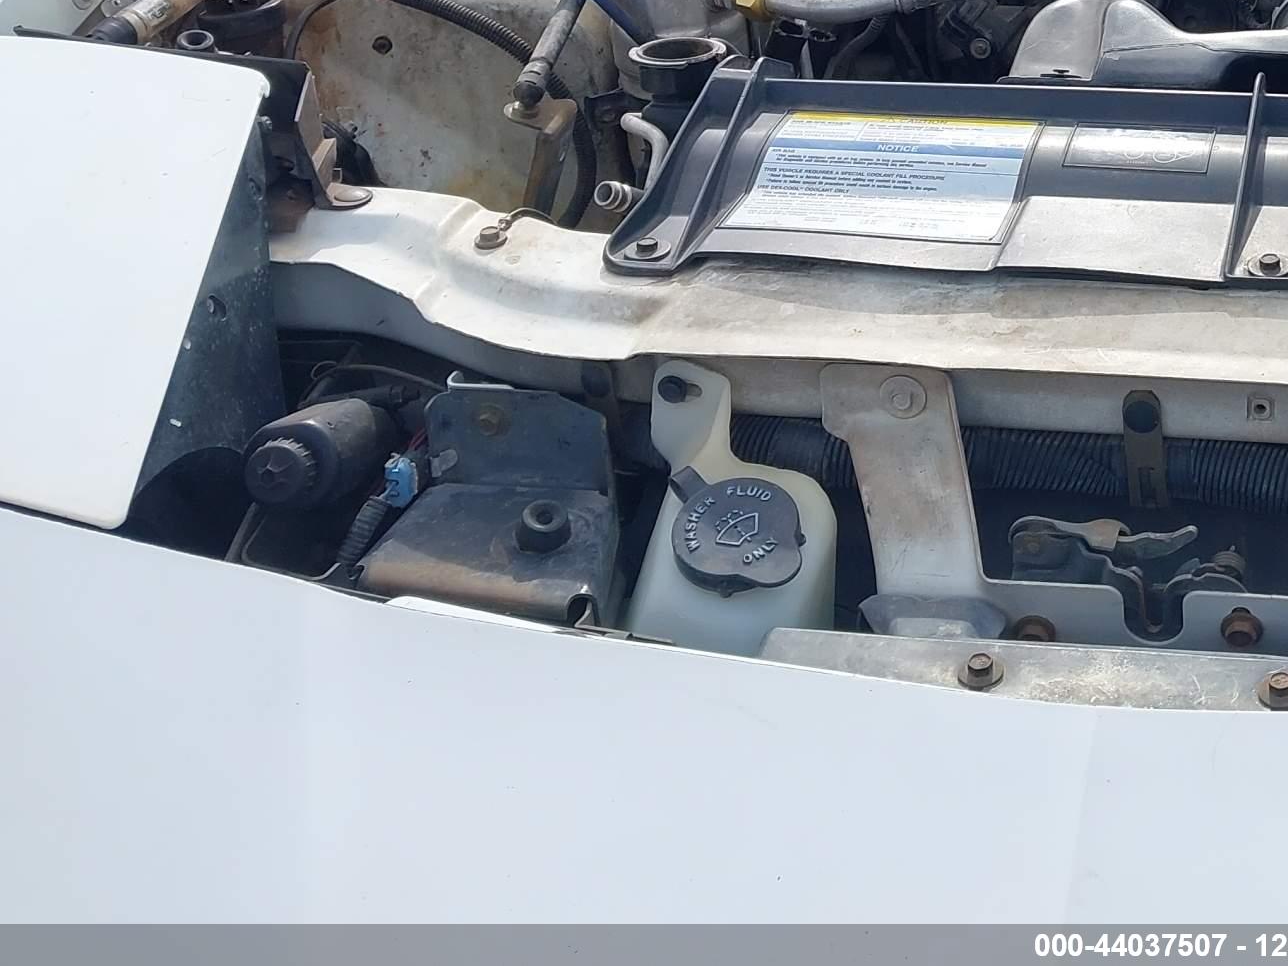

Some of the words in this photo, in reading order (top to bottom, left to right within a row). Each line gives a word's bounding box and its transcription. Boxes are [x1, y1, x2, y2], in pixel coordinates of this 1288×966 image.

[877, 144, 920, 153] NOTICE
[726, 485, 773, 502] FLUID
[683, 495, 716, 552] WASHER
[743, 536, 780, 564] ONLY
